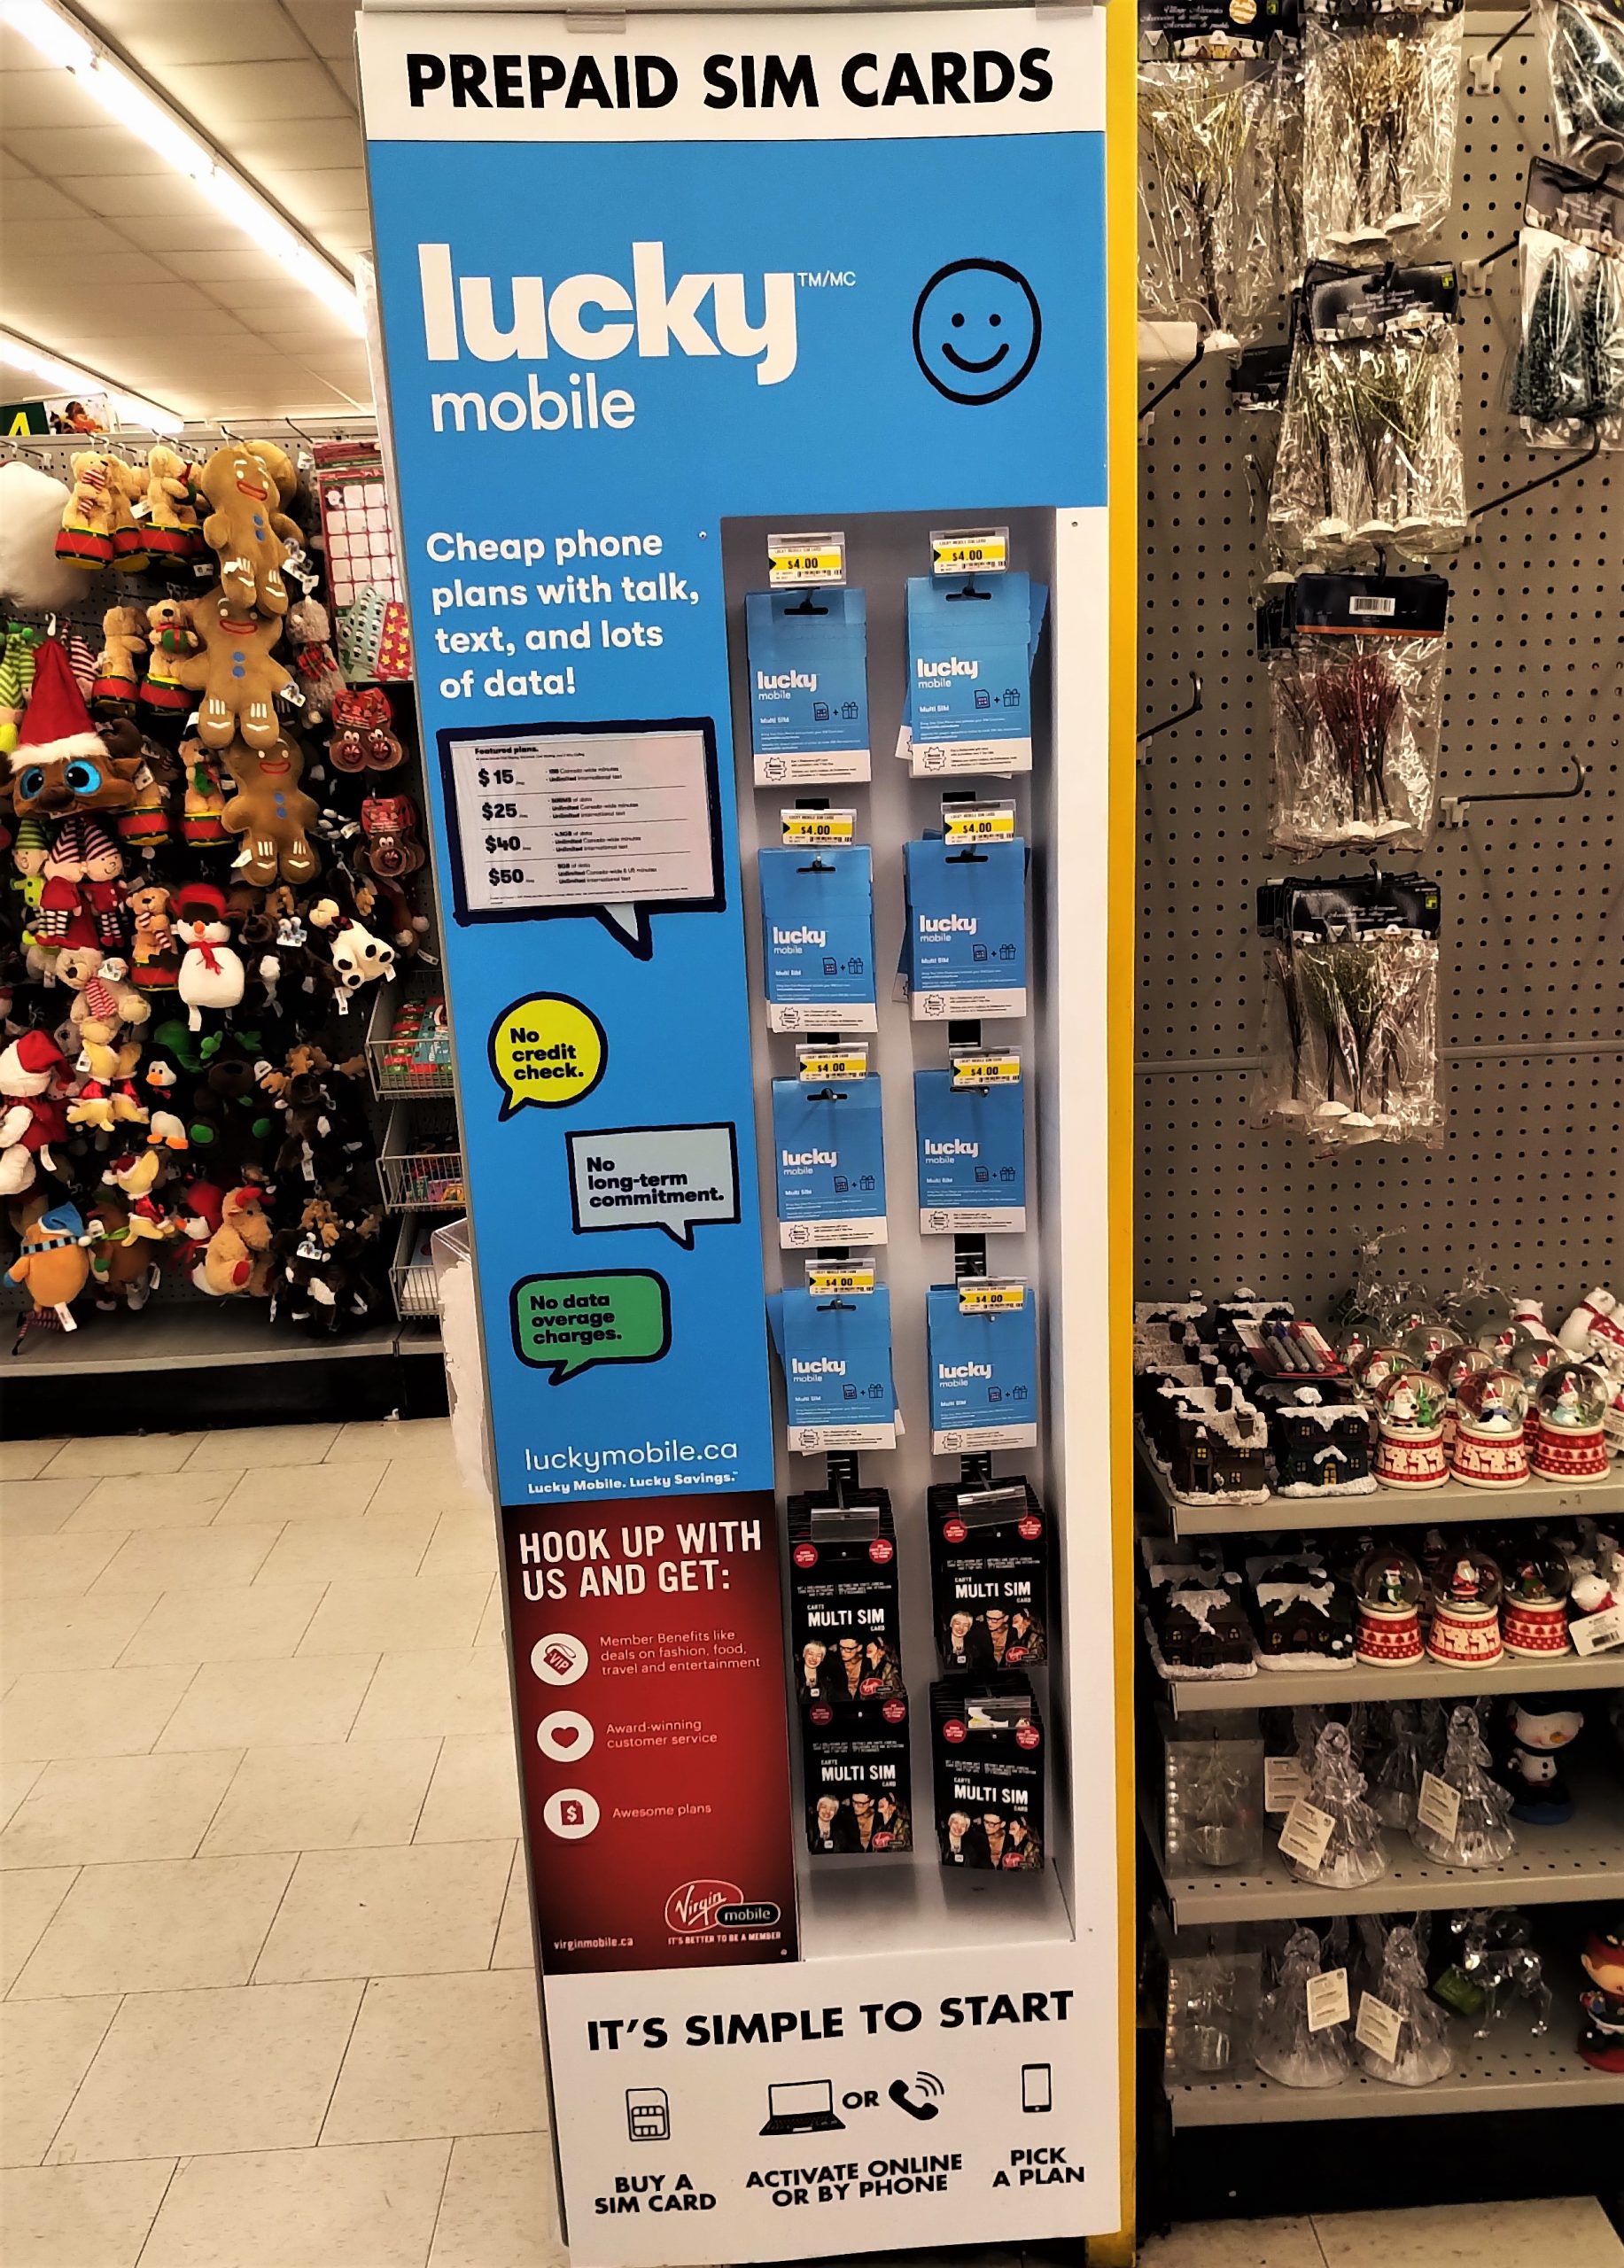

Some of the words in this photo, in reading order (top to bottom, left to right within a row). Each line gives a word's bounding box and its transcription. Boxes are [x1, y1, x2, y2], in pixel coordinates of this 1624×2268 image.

[406, 53, 679, 109] PREPAID
[703, 55, 820, 109] SIM
[841, 48, 1053, 106] CARDS
[417, 241, 798, 385] lucky
[431, 373, 635, 432] mobile
[426, 532, 546, 567] Cheap
[555, 528, 663, 566] phone
[952, 549, 983, 562] $4.00
[787, 557, 819, 570] $4.00
[431, 579, 528, 616] plans
[536, 574, 612, 605] with
[620, 571, 700, 606] talk,
[434, 625, 517, 656] text,
[524, 620, 591, 651] and
[600, 619, 664, 649] lots
[917, 656, 978, 680] lucky
[439, 669, 475, 699] of
[483, 666, 577, 698] data!
[757, 669, 817, 692] lucky
[918, 678, 952, 689] mobile
[758, 690, 791, 701] mobile
[474, 746, 512, 756] Featured
[513, 745, 539, 756] plans.
[481, 802, 517, 821] $25
[801, 825, 830, 835] $4.00
[962, 822, 991, 834] $4.00
[485, 835, 521, 854] $40
[488, 867, 524, 887] $50
[919, 913, 977, 936] lucky
[773, 926, 826, 948] lucky
[920, 933, 952, 943] mobile
[773, 945, 803, 955] mobile
[509, 1028, 540, 1044] No
[512, 1043, 577, 1062] credit
[513, 1062, 585, 1081] check.
[817, 1062, 845, 1073] $4.00
[970, 1066, 999, 1076] $4.00
[924, 1138, 979, 1158] lucky
[586, 1157, 616, 1172] No
[782, 1148, 837, 1168] lucky
[925, 1155, 955, 1164] mobile
[783, 1166, 814, 1176] mobile
[587, 1172, 688, 1192] long-term
[588, 1186, 725, 1208] commitment.
[826, 1278, 853, 1286] $4.00
[530, 1295, 558, 1311] No
[563, 1293, 610, 1309] data
[975, 1294, 1003, 1303] $4.00
[532, 1311, 616, 1328] overage
[532, 1329, 623, 1346] charges.
[791, 1356, 846, 1376] lucky
[938, 1361, 991, 1379] lucky
[793, 1374, 823, 1383] mobile
[939, 1379, 968, 1388] mobile
[524, 1439, 738, 1474] luckymobile.ca
[528, 1483, 571, 1495] Lucky
[573, 1477, 627, 1491] Mobile.
[629, 1474, 672, 1489] Lucky
[519, 1528, 610, 1565] HOOK
[621, 1525, 664, 1558] UP
[676, 1519, 762, 1555] WITH
[522, 1568, 568, 1602] US
[579, 1564, 646, 1598] AND
[658, 1559, 731, 1593] GET:
[954, 1581, 999, 1600] MULTI
[1004, 1581, 1032, 1597] SIM
[807, 1610, 853, 1627] MULTI
[857, 1608, 885, 1626] SIM
[600, 1635, 654, 1648] Member
[657, 1631, 711, 1644] Benefits
[712, 1629, 736, 1642] like
[548, 1652, 570, 1672] VIP
[600, 1649, 636, 1662] deals
[638, 1650, 657, 1660] on
[658, 1644, 710, 1659] fashion,
[602, 1663, 639, 1676] travel
[641, 1661, 665, 1674] and
[669, 1658, 762, 1673] entertainment
[606, 1720, 703, 1736] Award-winning
[607, 1736, 668, 1750] customer
[671, 1732, 719, 1746] service
[821, 1766, 865, 1783] MULTI
[869, 1764, 897, 1781] SIM
[953, 1783, 998, 1804] MULTI
[1000, 1787, 1030, 1806] SIM
[612, 1806, 674, 1819] Awesome
[677, 1804, 712, 1819] plans
[675, 1884, 727, 1927] Virgin
[724, 1907, 772, 1922] mobile
[553, 1937, 634, 1952] virginmobile.ca
[668, 1936, 684, 1946] IT'S
[685, 1934, 715, 1946] BETTER
[717, 1933, 727, 1944] TO
[728, 1933, 739, 1943] BE
[741, 1933, 748, 1942] A
[748, 1931, 781, 1942] MEMBER
[686, 2007, 843, 2047] SIMPLE
[859, 2000, 923, 2035] TO
[939, 1990, 1075, 2030] START
[842, 2090, 880, 2111] OR
[1010, 2147, 1068, 2168] PICK
[745, 2163, 859, 2189] ACTIVATE
[866, 2153, 963, 2178] ONLINE
[991, 2171, 1012, 2188] A
[1019, 2166, 1086, 2186] PLAN
[614, 2174, 667, 2194] BUY
[673, 2173, 694, 2192] A
[772, 2188, 810, 2208] OR
[817, 2184, 851, 2202] BY
[859, 2174, 949, 2199] PHONE
[594, 2196, 644, 2215] SIM
[648, 2193, 718, 2213] CARD
